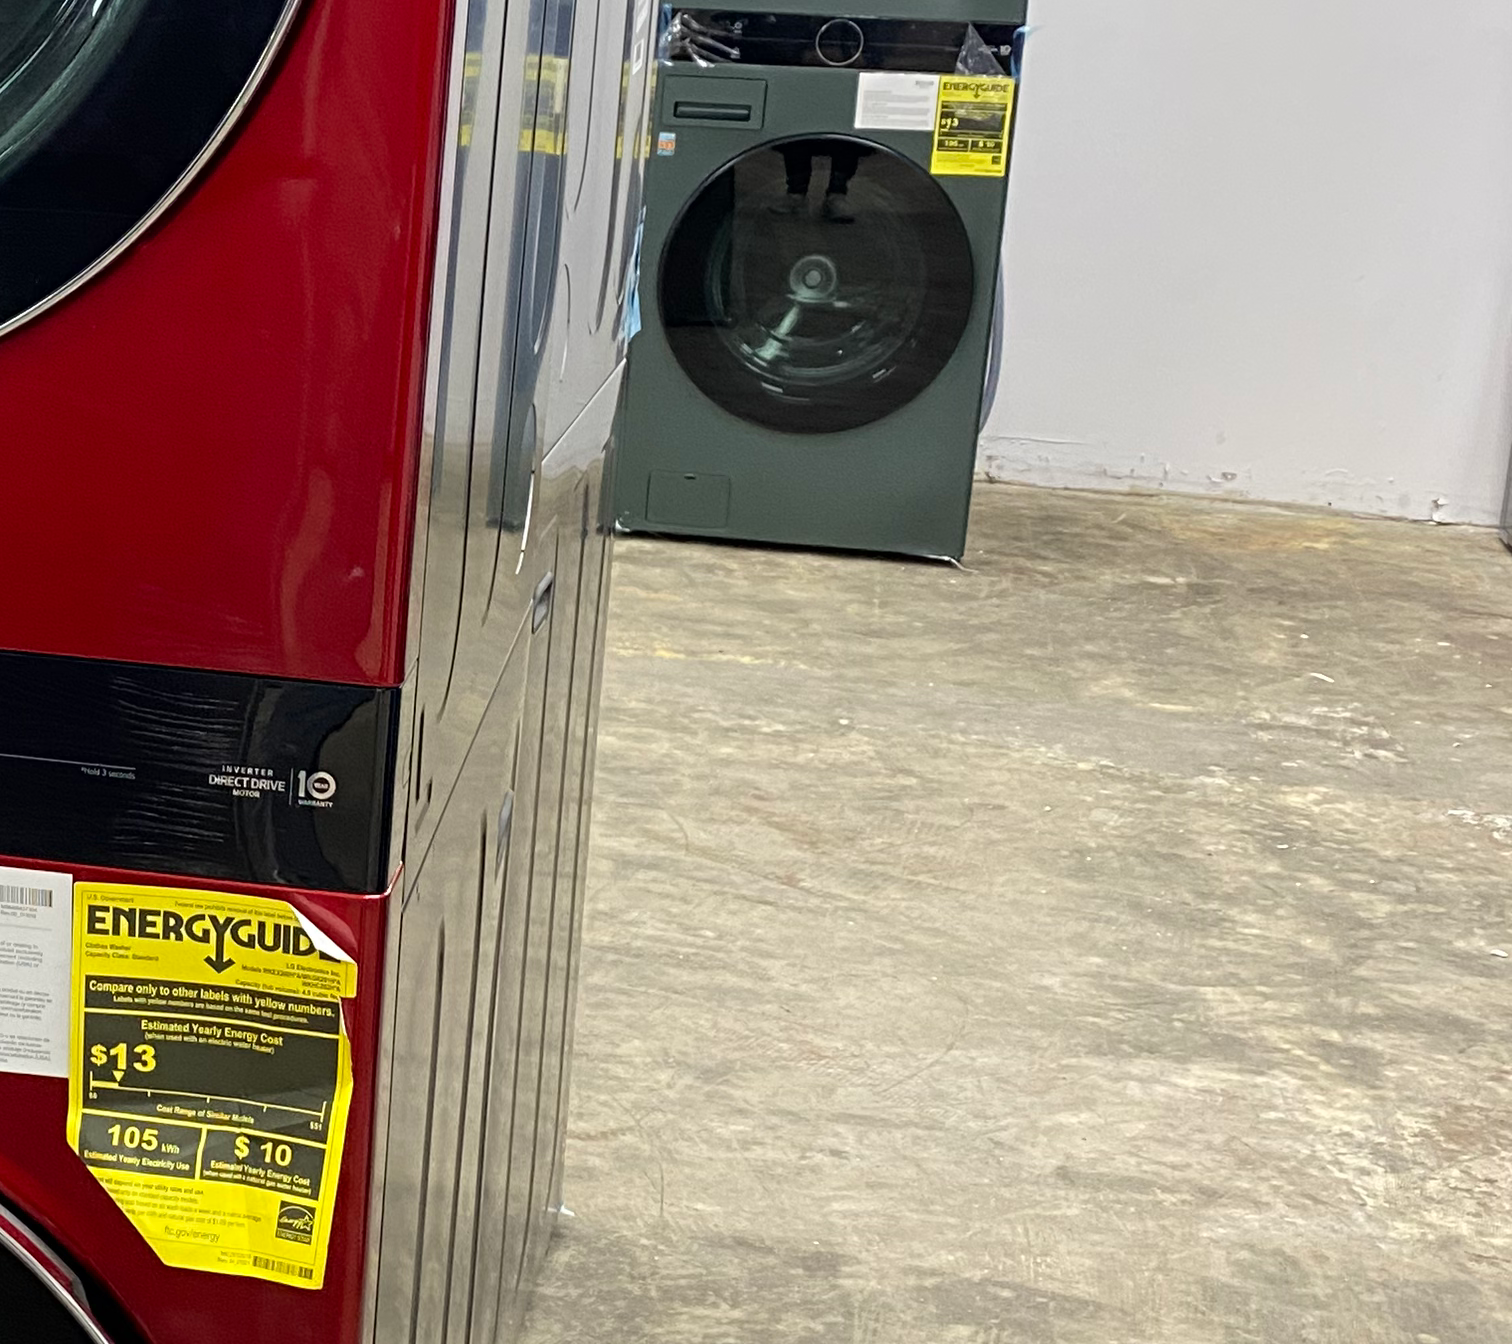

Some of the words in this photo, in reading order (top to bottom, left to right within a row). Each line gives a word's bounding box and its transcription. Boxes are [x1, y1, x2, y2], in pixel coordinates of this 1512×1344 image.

[208, 774, 250, 788] DIRECT
[250, 777, 286, 792] DRIVE
[222, 765, 274, 777] INVERTER
[232, 788, 261, 798] MOTOR
[297, 770, 337, 800] 10
[89, 979, 134, 994] Compare
[136, 983, 157, 997] only
[159, 986, 170, 996] to
[172, 986, 198, 998] other
[200, 988, 229, 1002] labels
[231, 992, 252, 1004] with
[254, 997, 286, 1010] yellow
[288, 1002, 335, 1017] numbers.
[141, 1020, 189, 1033] Estimated
[192, 1023, 222, 1038] Yearly
[225, 1027, 258, 1042] Energy
[260, 1033, 283, 1046] Cost
[90, 1042, 157, 1073] $13
[156, 1103, 173, 1114] Cost
[174, 1106, 196, 1118] Range
[197, 1108, 206, 1118] of
[207, 1110, 231, 1121] Similar
[107, 1124, 159, 1151] 105
[161, 1142, 180, 1154] kWh
[234, 1134, 250, 1160] $
[260, 1141, 292, 1167] 10
[84, 1149, 118, 1162] Estimated
[119, 1154, 140, 1167] Yearly
[141, 1157, 175, 1170] Electricity
[176, 1161, 190, 1171] Use
[210, 1160, 243, 1172] Estimated
[243, 1163, 266, 1178] Yearly
[266, 1169, 292, 1184] Energy
[293, 1175, 311, 1187] Cost
[164, 1225, 220, 1243] ftc.gov/energy
